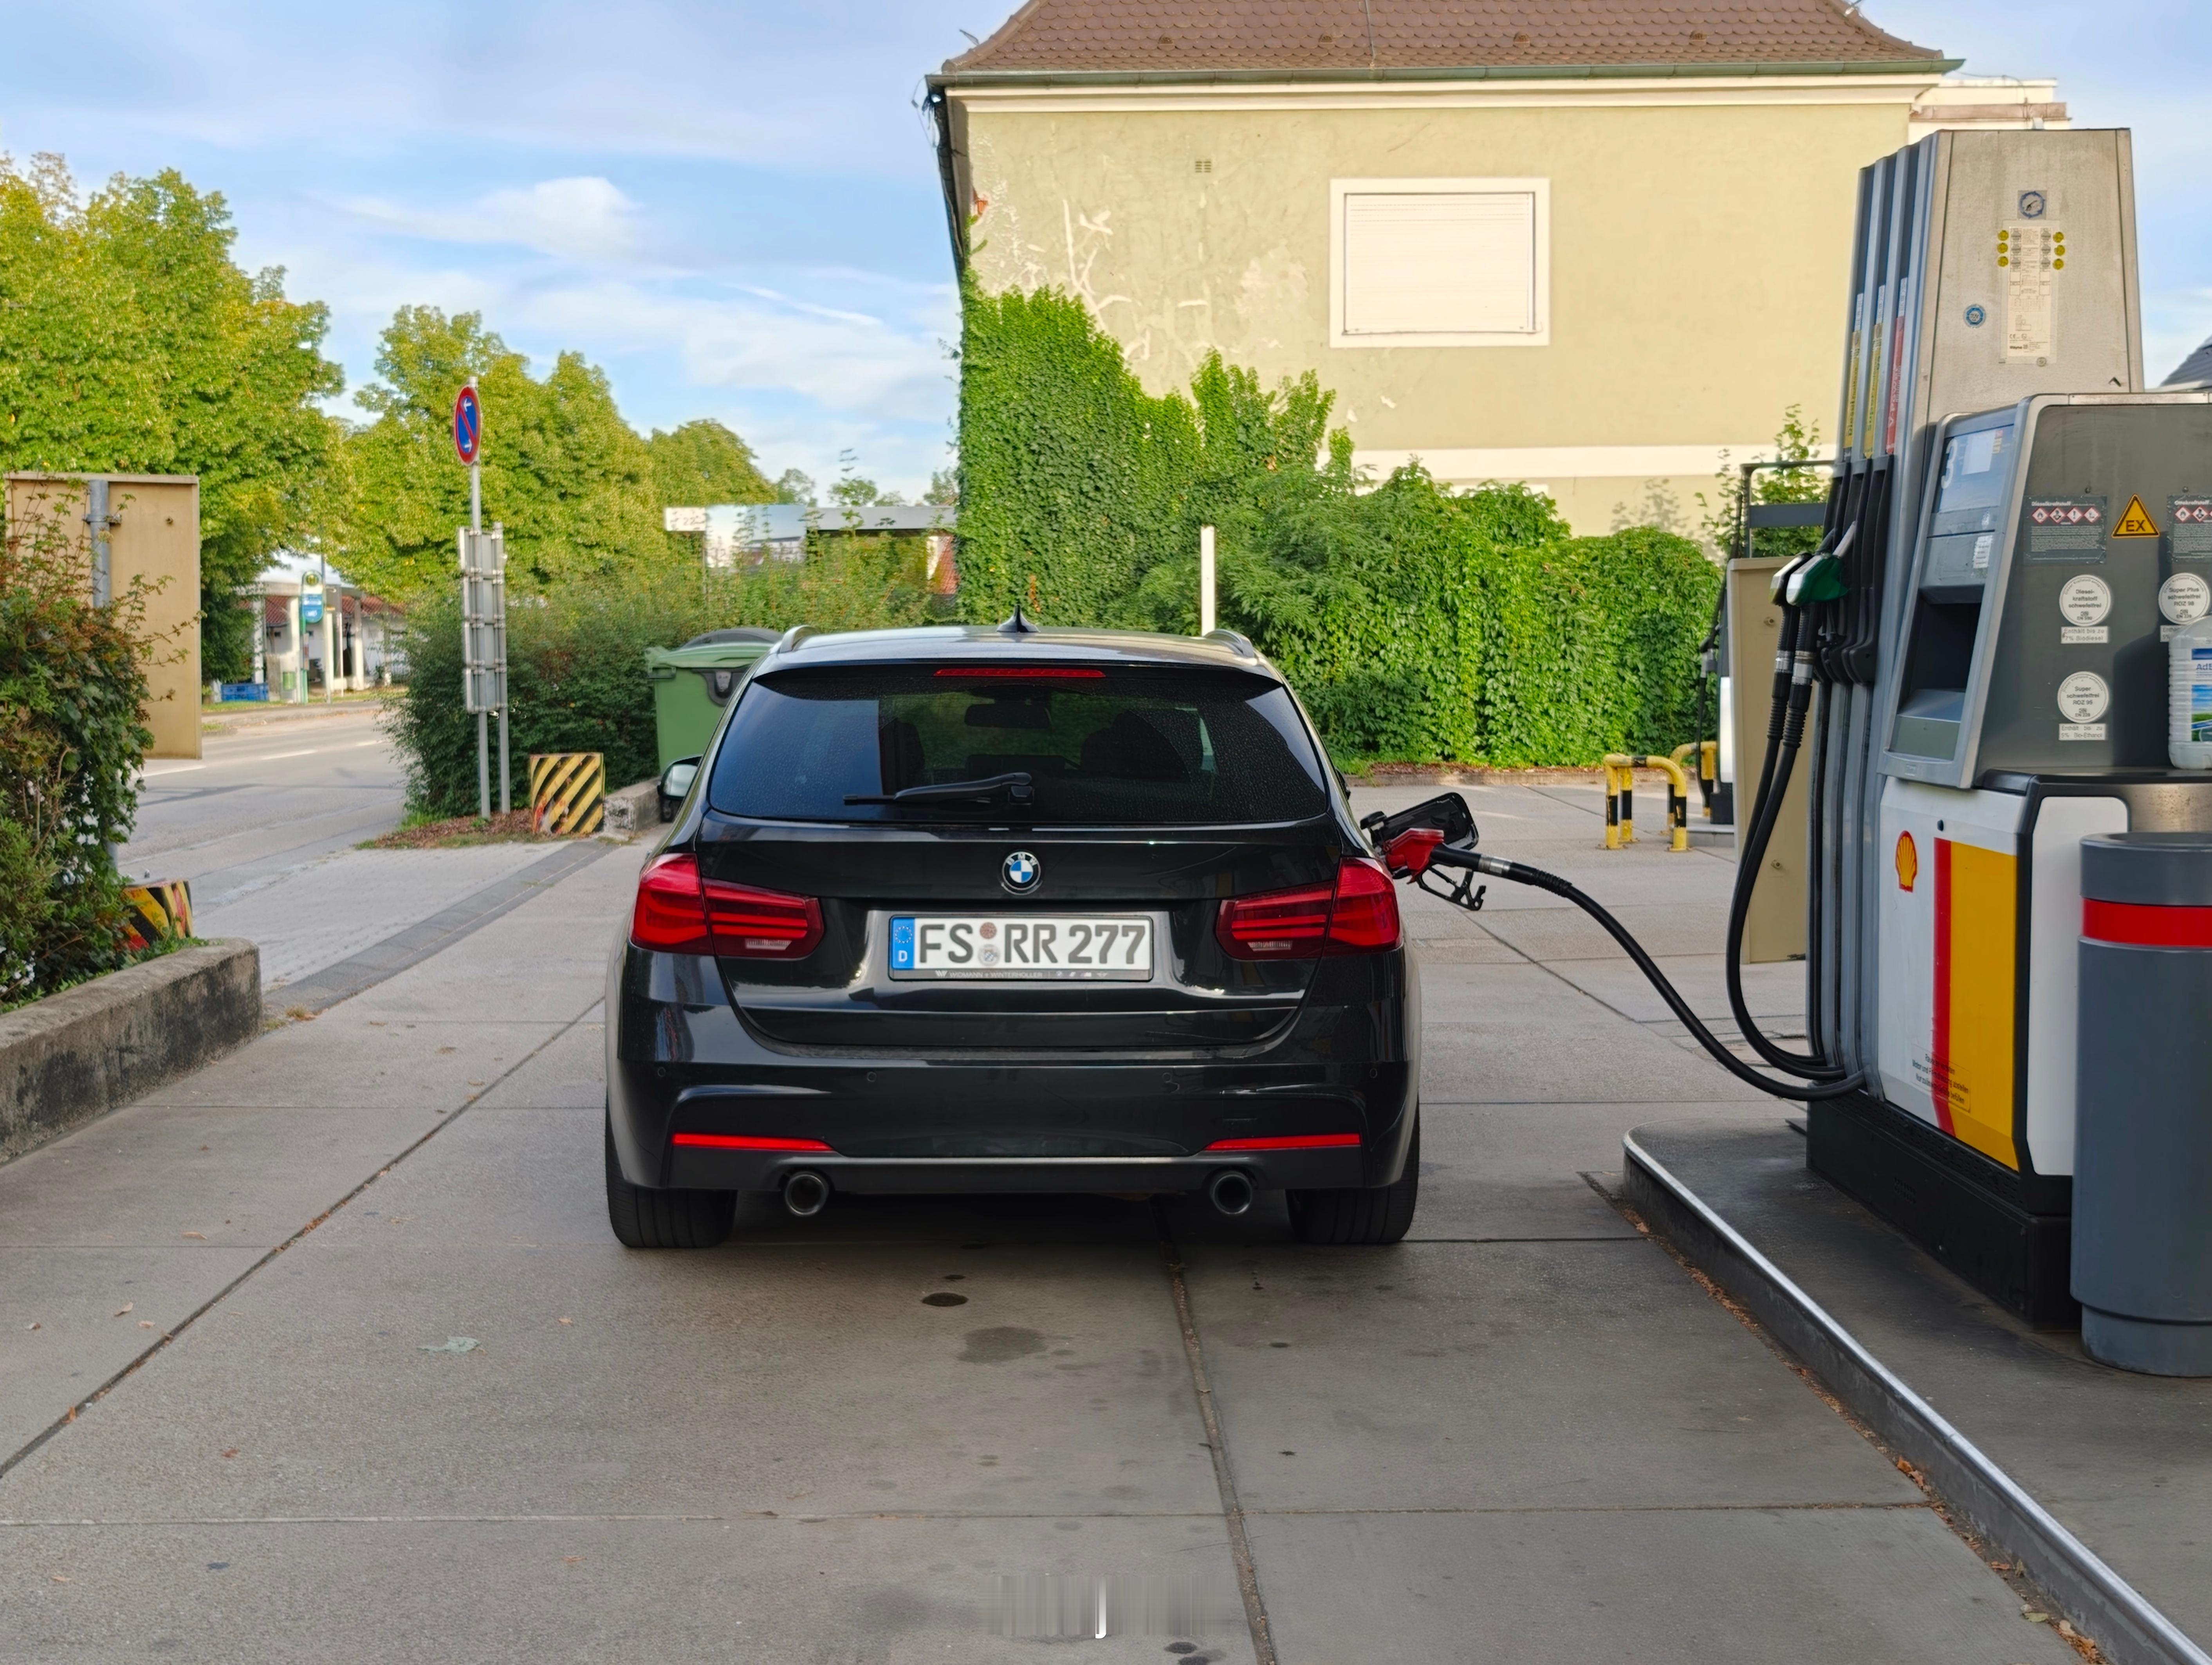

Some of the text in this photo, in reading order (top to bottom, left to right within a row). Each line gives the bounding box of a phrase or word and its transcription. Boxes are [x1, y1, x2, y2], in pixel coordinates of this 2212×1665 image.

[1941, 436, 1958, 489] 3
[2125, 520, 2146, 532] EX
[1006, 853, 1038, 866] BMW
[920, 923, 1146, 965] FS RR 277
[898, 950, 908, 962] D
